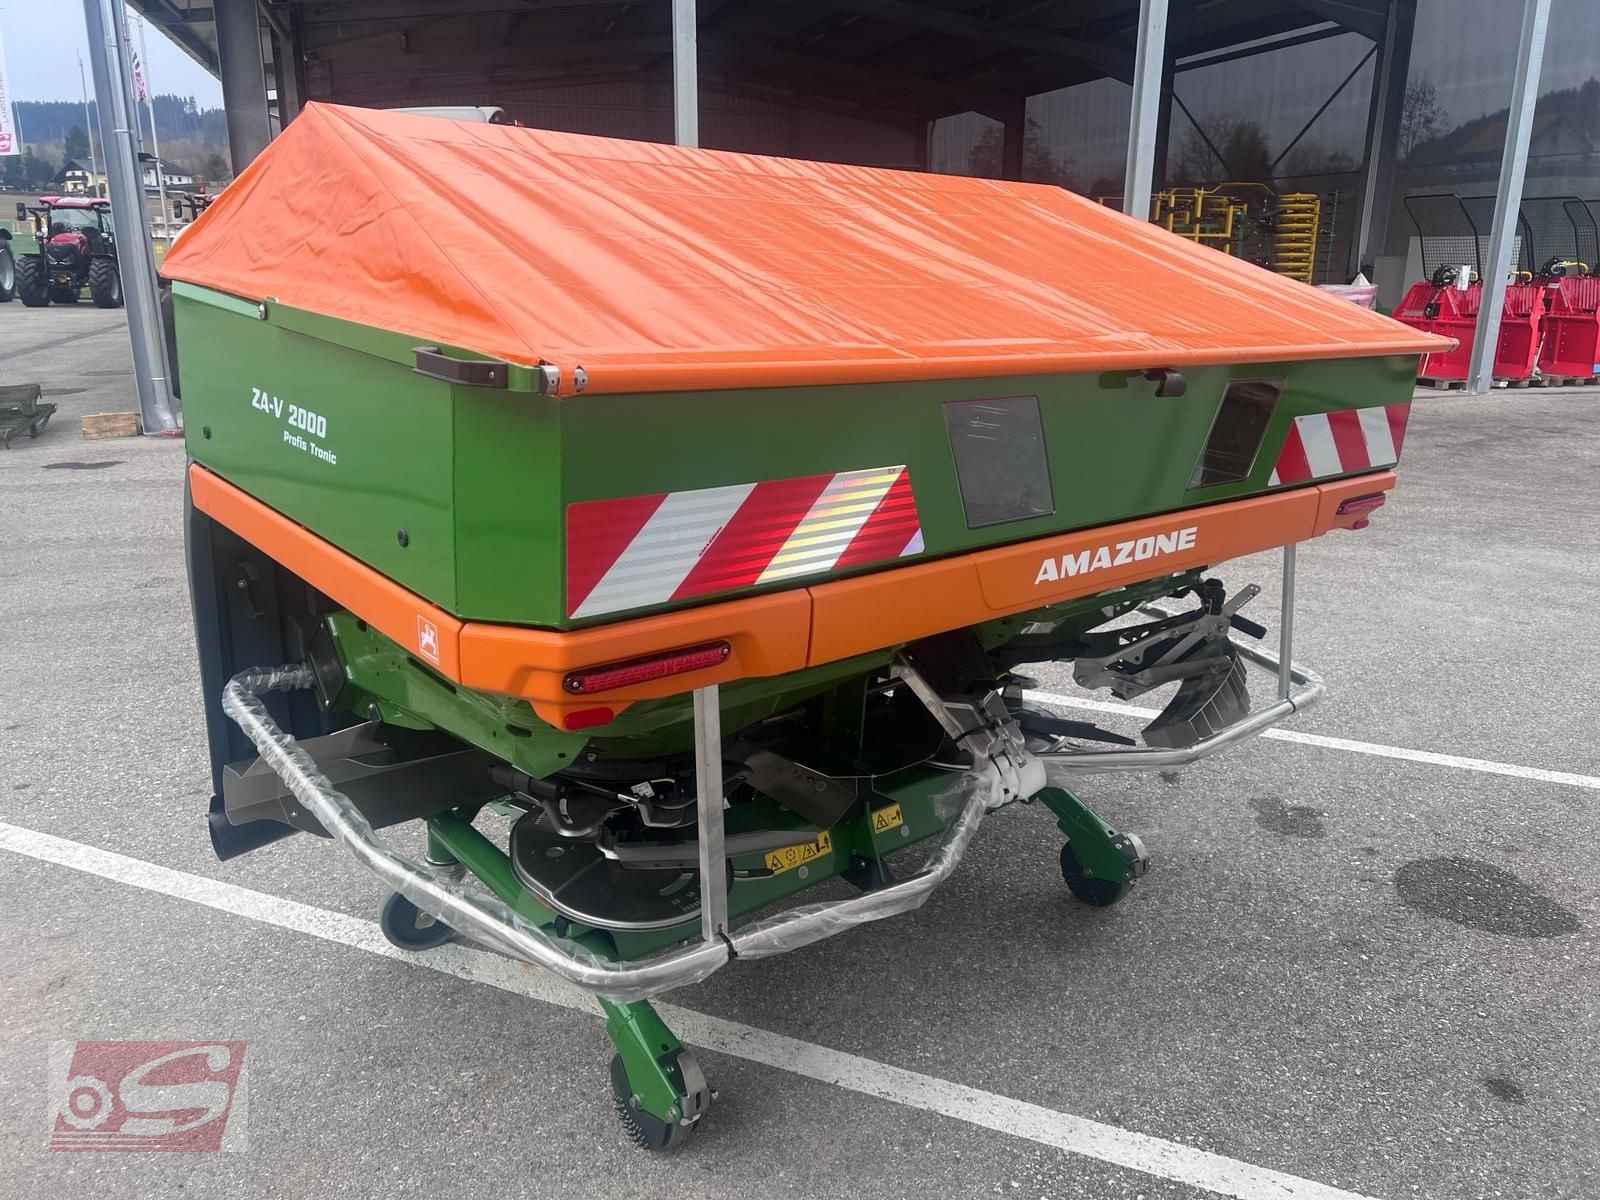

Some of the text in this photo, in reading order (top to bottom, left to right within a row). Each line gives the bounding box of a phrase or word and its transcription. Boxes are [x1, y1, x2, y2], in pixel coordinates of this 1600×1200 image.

[252, 387, 326, 438] ZA-V 2000
[283, 430, 336, 464] Profis Tronic
[1034, 527, 1198, 585] AMAZONE
